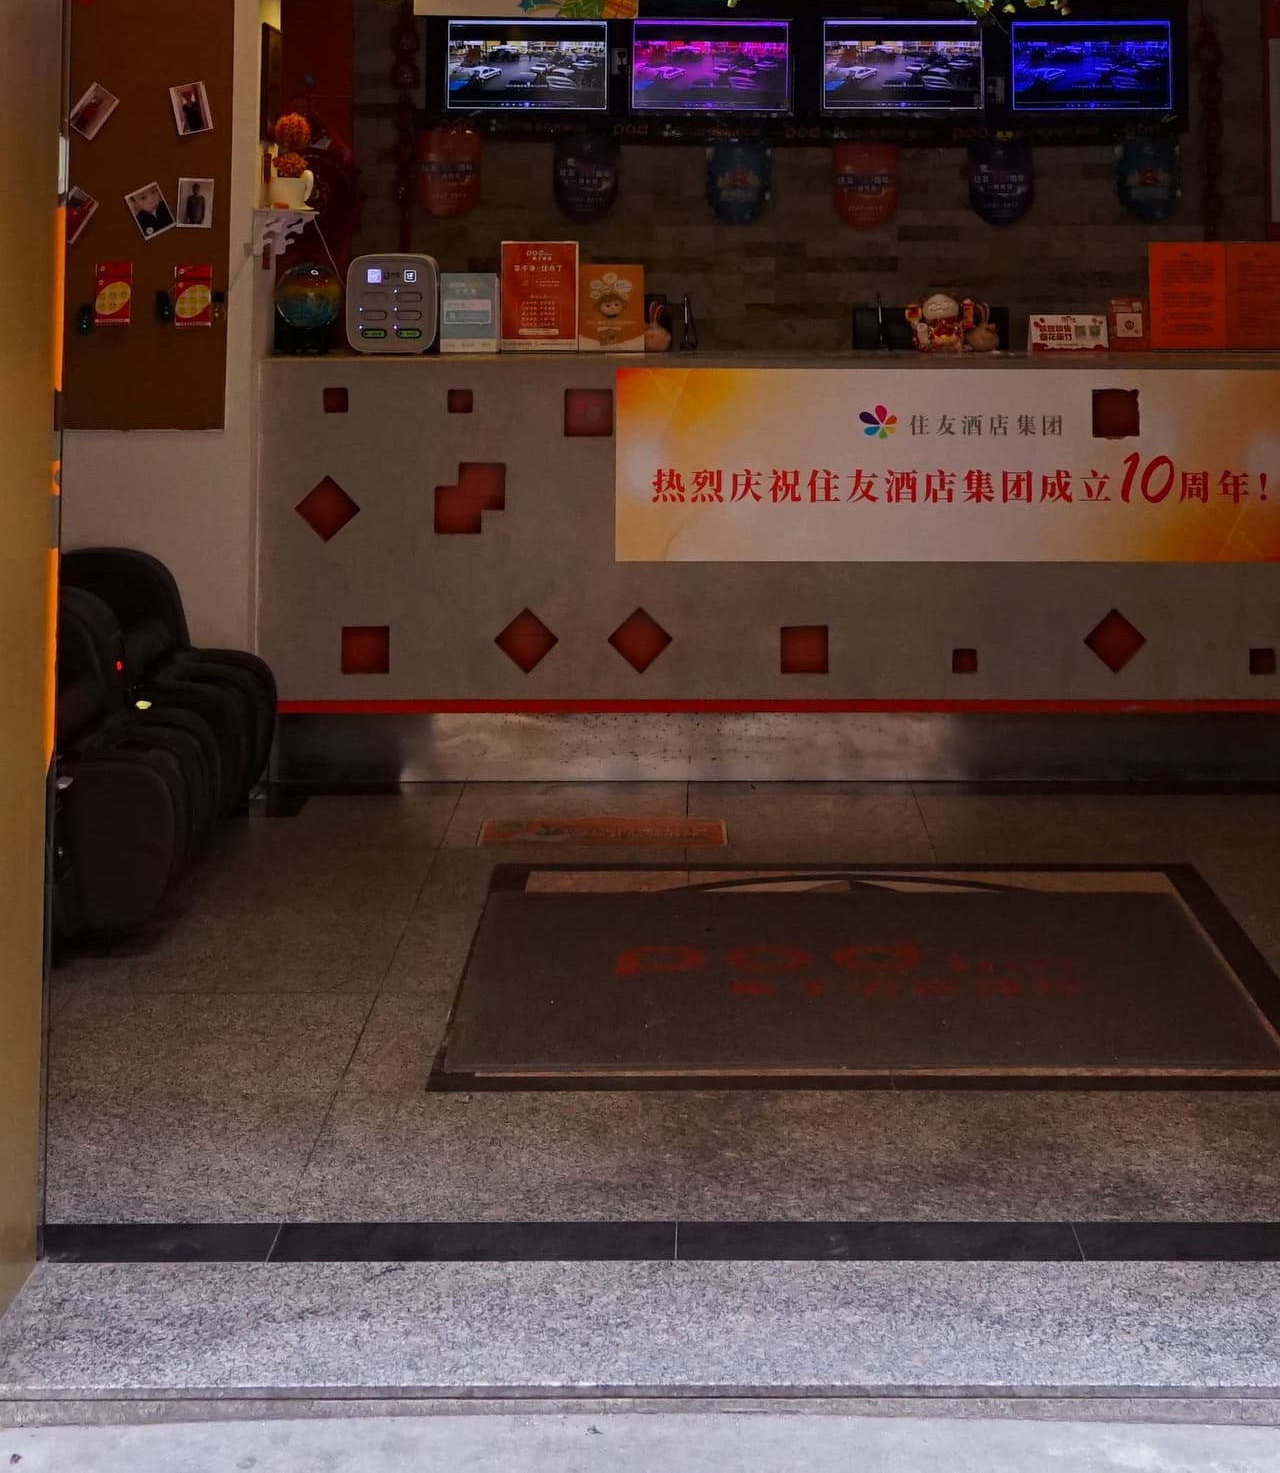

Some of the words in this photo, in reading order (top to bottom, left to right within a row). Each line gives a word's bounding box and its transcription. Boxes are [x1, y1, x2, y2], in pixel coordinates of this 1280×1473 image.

[909, 412, 1065, 437] 住友酒店集团
